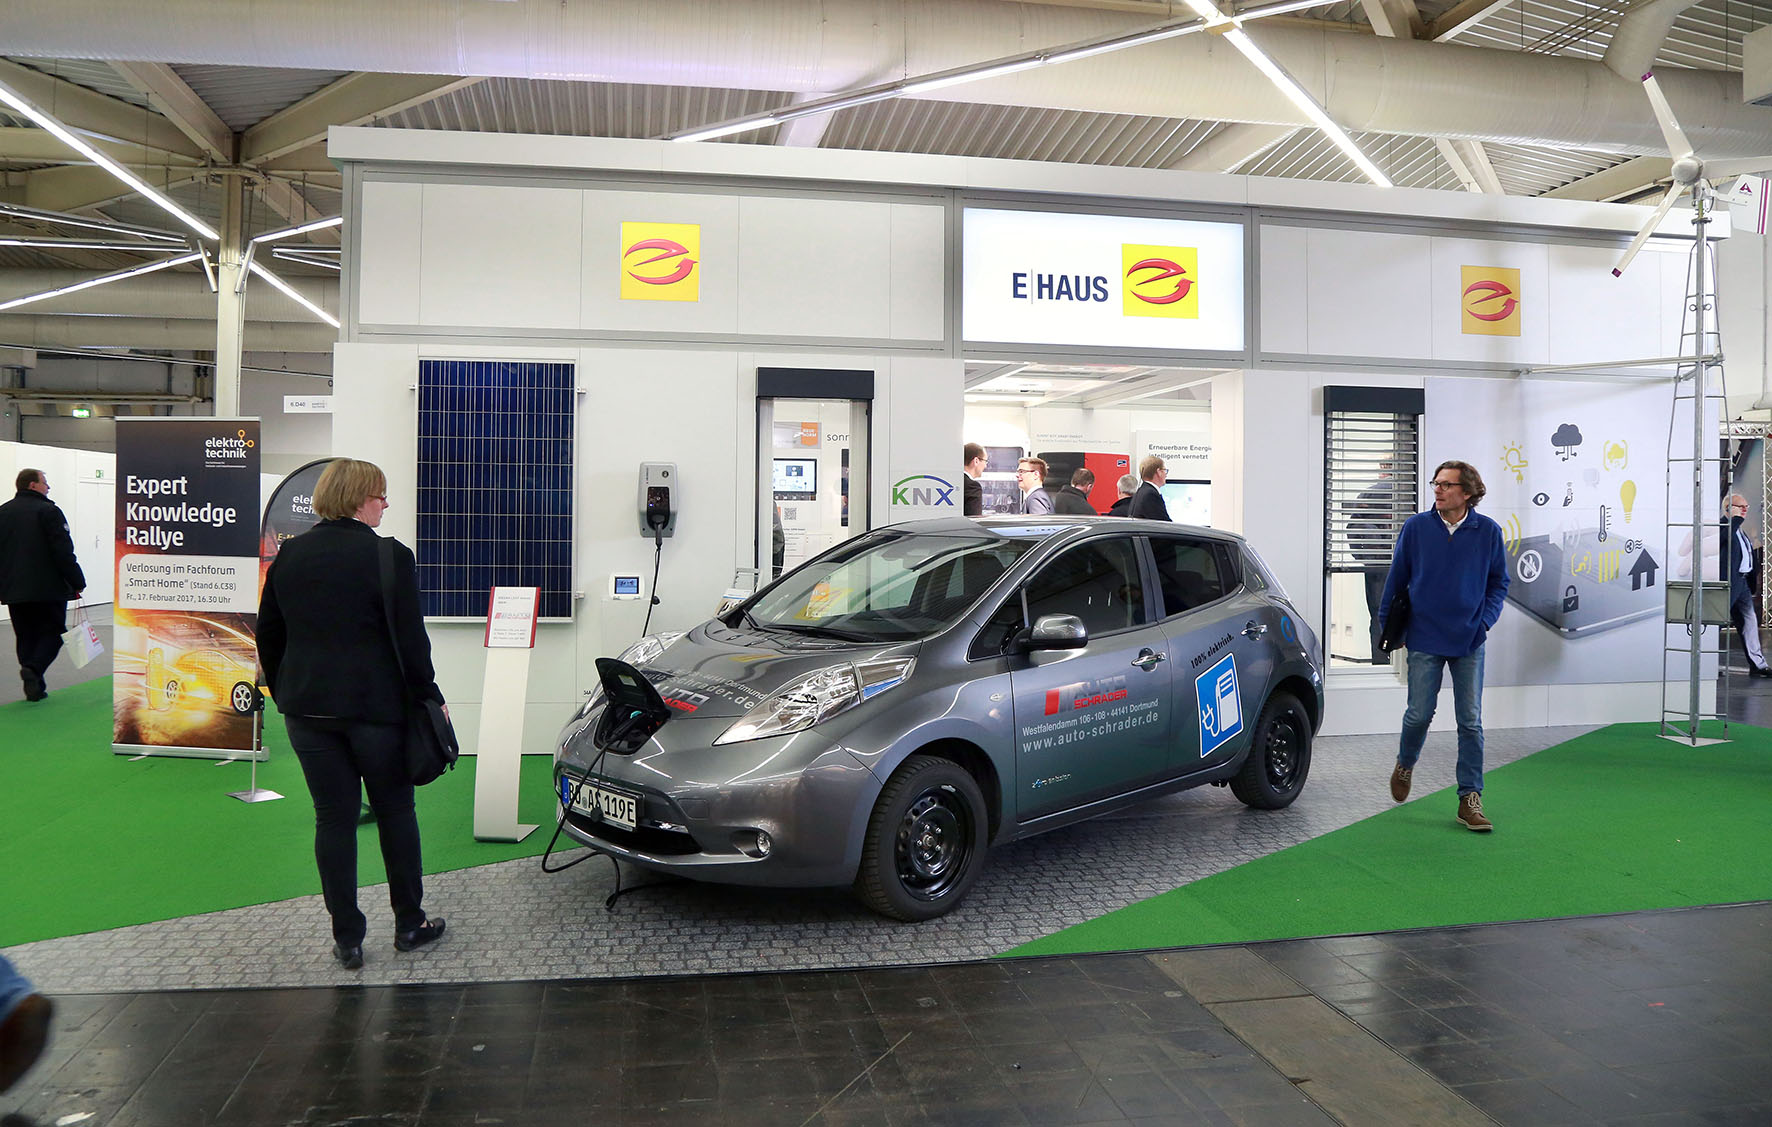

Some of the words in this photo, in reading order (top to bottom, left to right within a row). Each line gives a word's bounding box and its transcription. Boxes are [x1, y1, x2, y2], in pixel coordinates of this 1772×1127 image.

[205, 437, 246, 448] elektro
[205, 448, 247, 458] technik
[126, 475, 188, 499] Expert
[892, 487, 955, 505] KNX
[292, 495, 314, 505] ele
[126, 502, 237, 528] Knowledge
[126, 525, 184, 551] Rallye
[126, 563, 171, 576] Verlosung
[173, 564, 185, 574] im
[187, 564, 236, 576] Fachforum
[190, 582, 213, 591] (Stand
[214, 583, 237, 592] 6.C38)
[138, 594, 149, 602] 17.
[150, 593, 176, 602] Februar
[177, 595, 197, 604] 2017,
[198, 596, 218, 604] 16.30
[218, 596, 232, 604] Uhr
[725, 679, 768, 700] Dortmund
[1074, 689, 1128, 710] SCHRADER
[1022, 718, 1078, 737] Westfalendamm
[1111, 707, 1129, 717] 44141
[1129, 698, 1159, 713] Dortmund
[1022, 711, 1159, 753] www.auto-schrader.de
[604, 795, 635, 823] 119E
